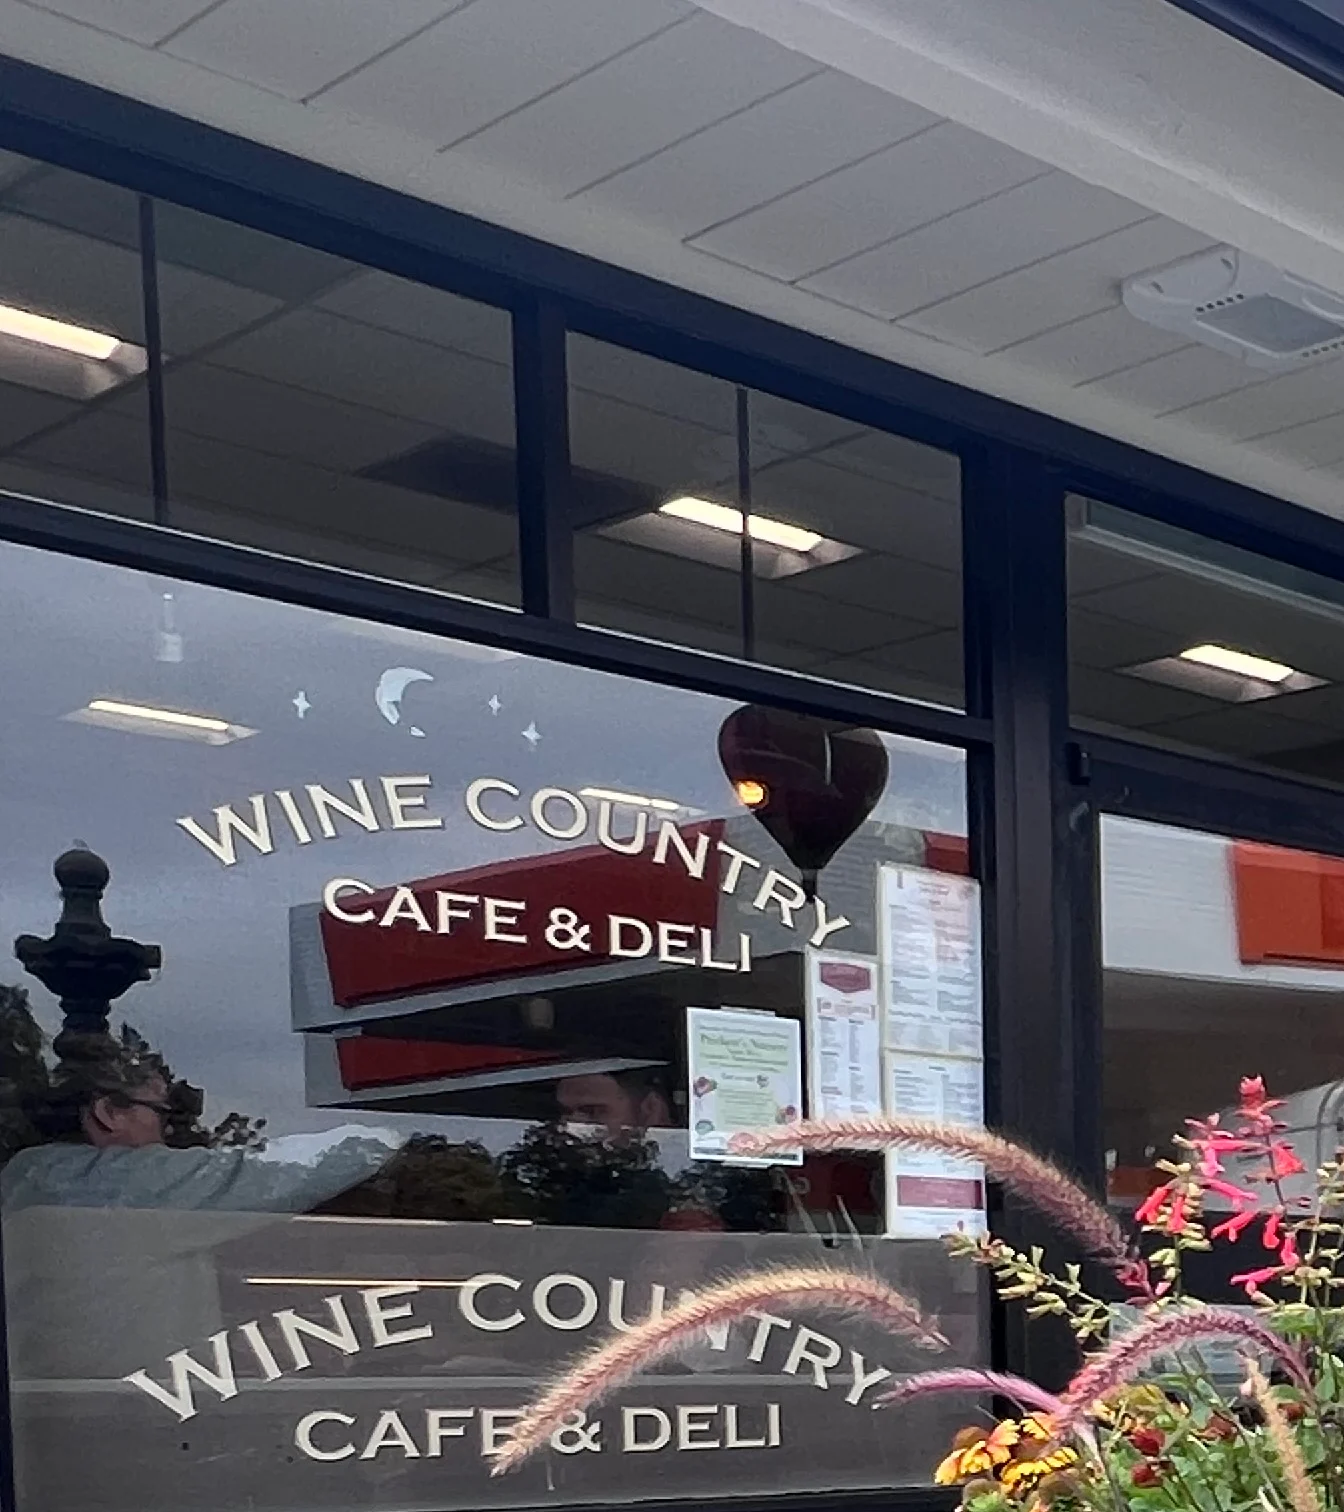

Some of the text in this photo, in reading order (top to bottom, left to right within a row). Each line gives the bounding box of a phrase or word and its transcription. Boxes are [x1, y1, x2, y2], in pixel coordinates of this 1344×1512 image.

[178, 774, 852, 949] WINE COUNTRY
[323, 878, 753, 973] CAFE & DELI
[123, 1273, 892, 1424] WINE COUTRY
[295, 1403, 782, 1461] CAFE & DELI
